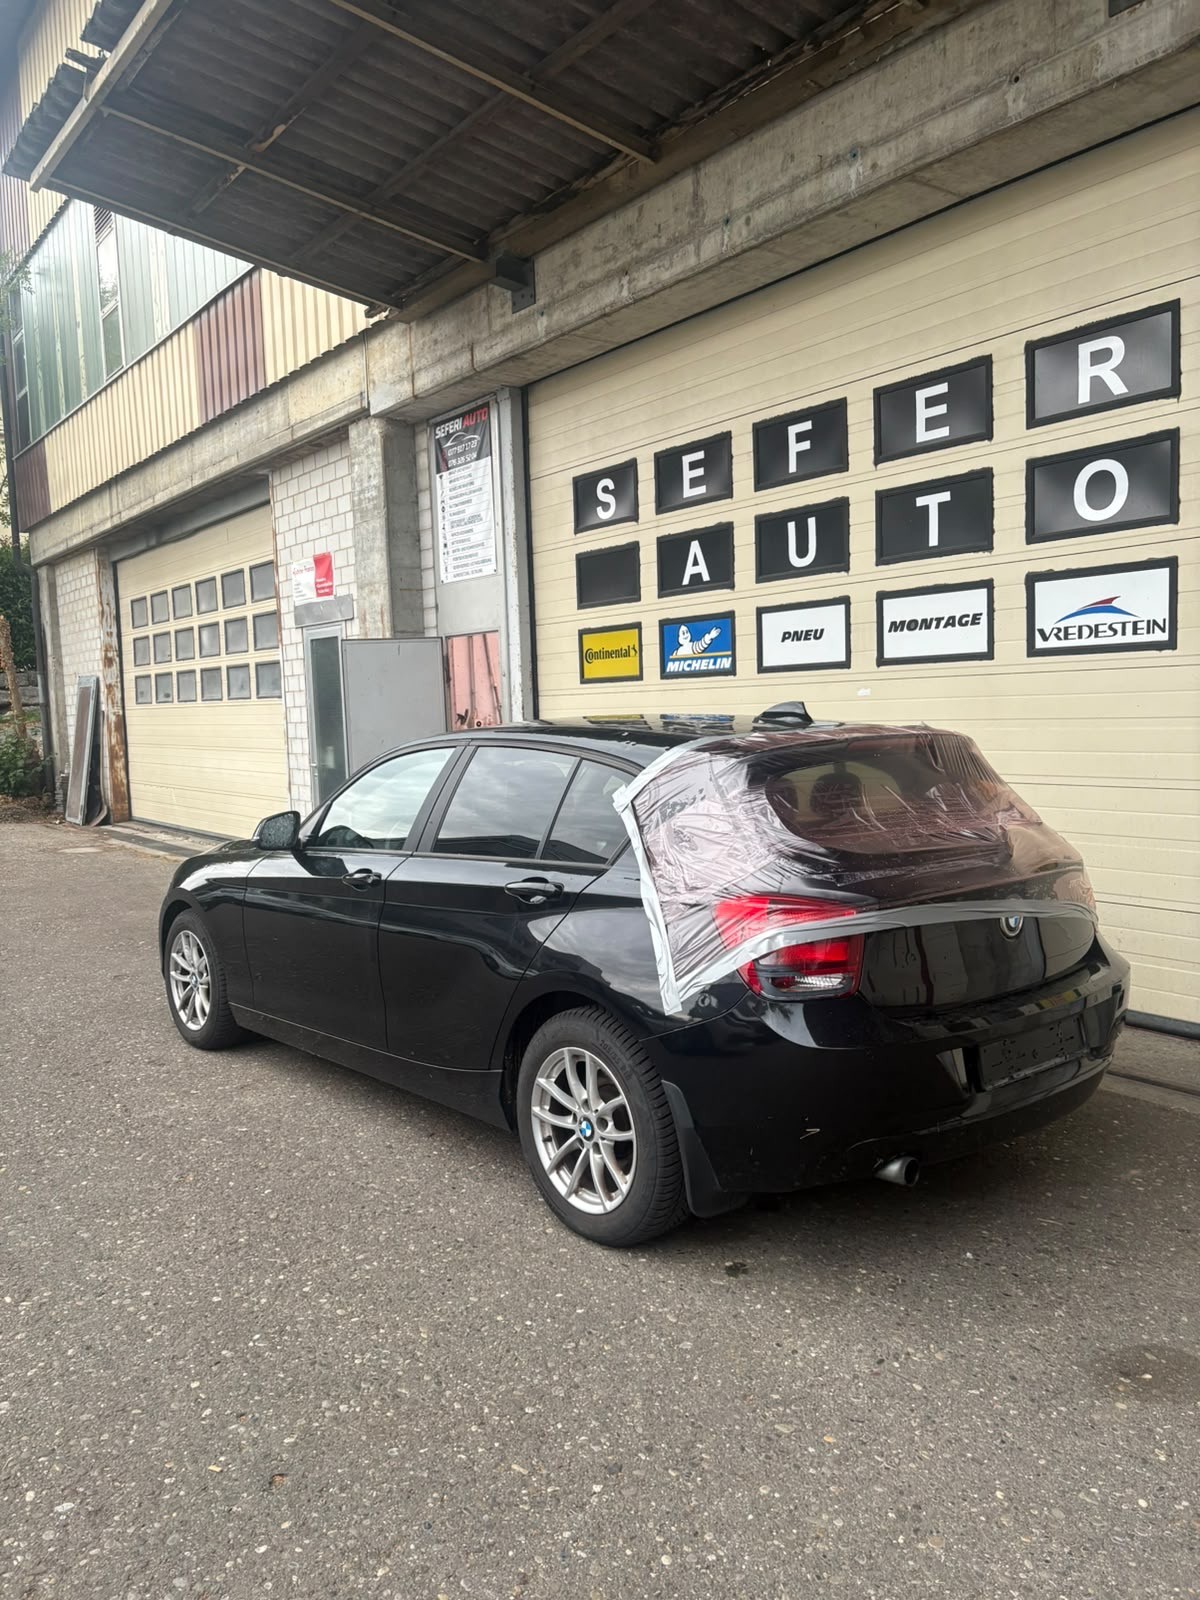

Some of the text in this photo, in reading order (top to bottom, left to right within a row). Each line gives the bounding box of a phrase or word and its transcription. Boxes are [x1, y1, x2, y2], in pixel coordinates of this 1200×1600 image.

[435, 408, 488, 439] SEFERI AUTO
[887, 612, 983, 633] MONTAGE
[1037, 617, 1167, 642] VREDESTEIN
[780, 628, 825, 643] PNEU
[584, 645, 631, 664] Continental
[665, 657, 731, 673] MICHELIN
